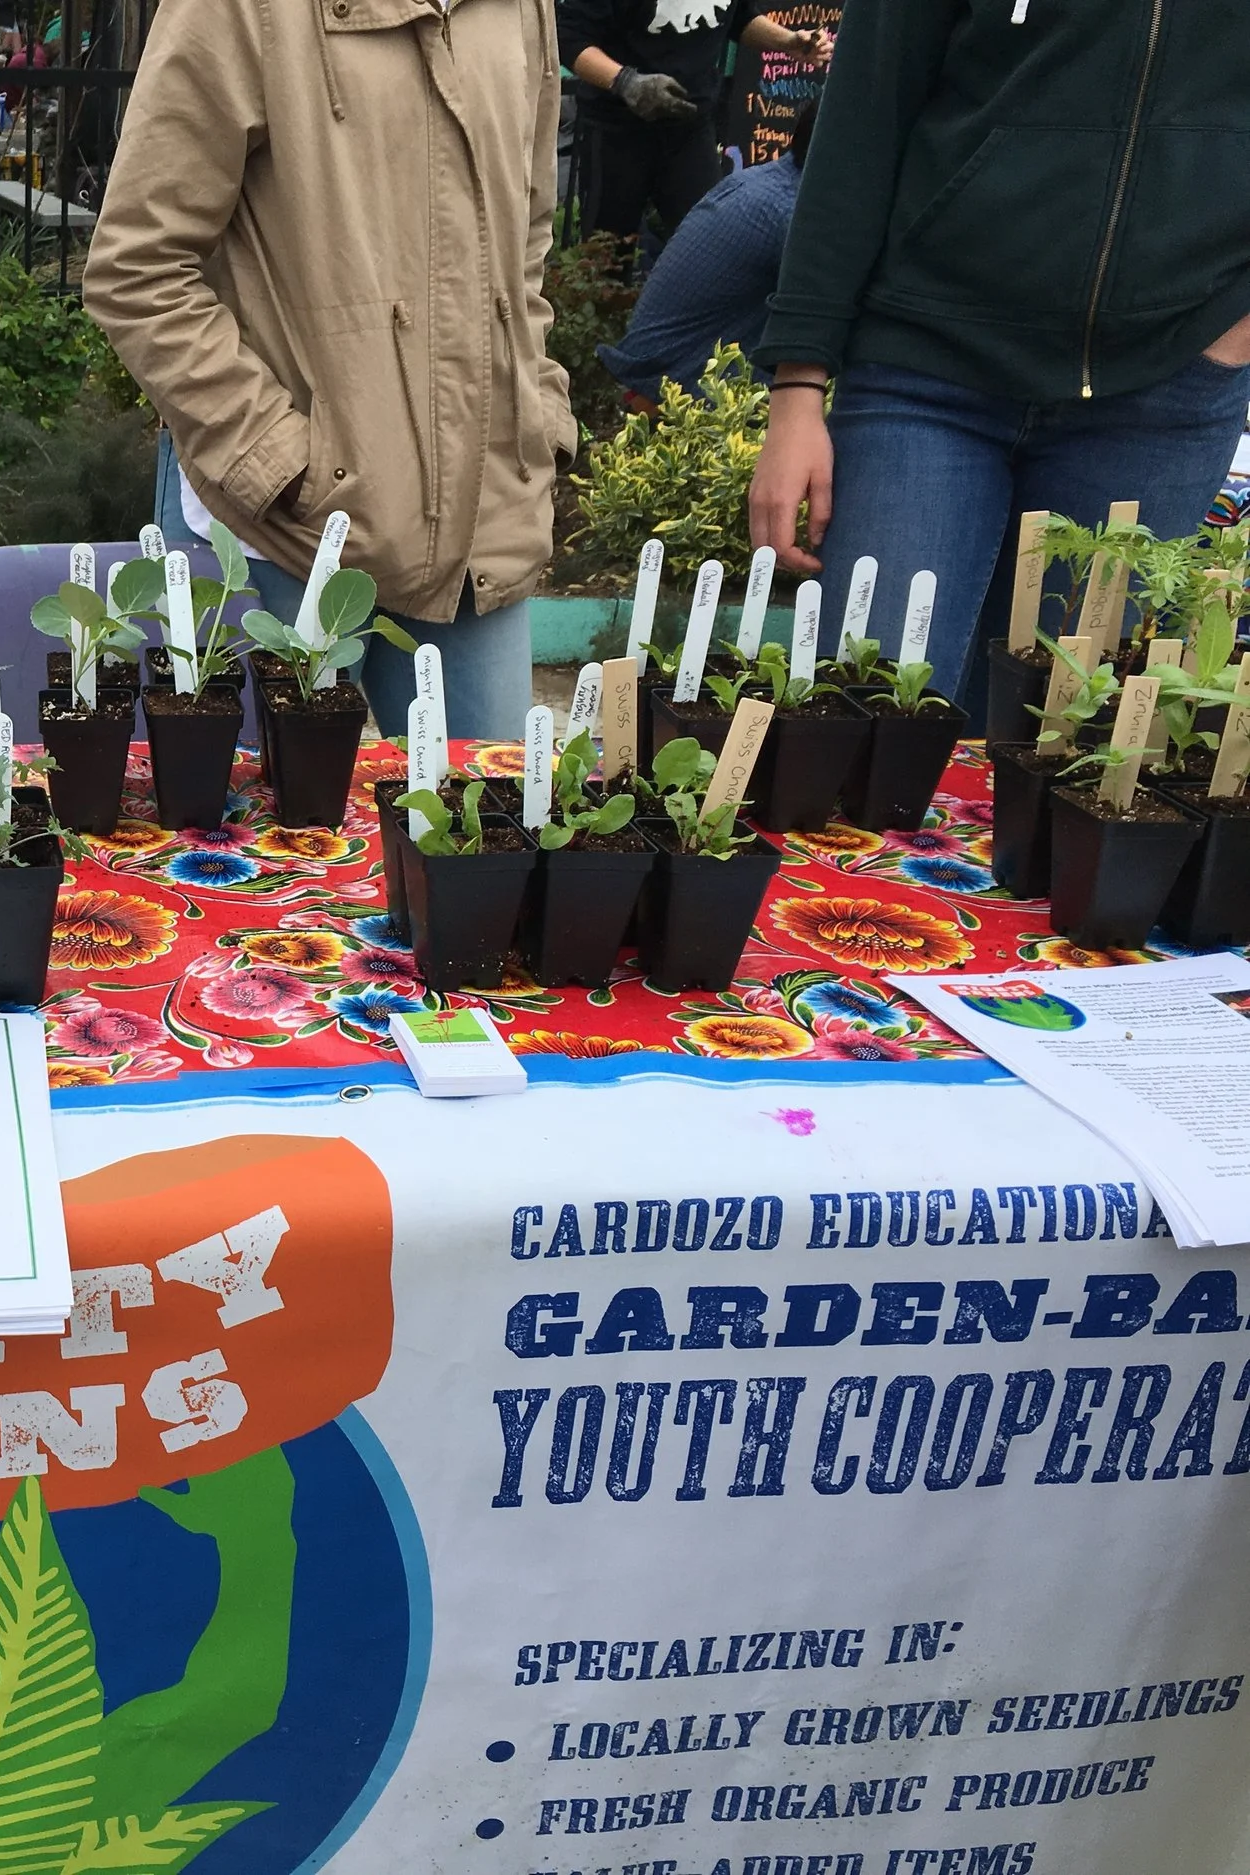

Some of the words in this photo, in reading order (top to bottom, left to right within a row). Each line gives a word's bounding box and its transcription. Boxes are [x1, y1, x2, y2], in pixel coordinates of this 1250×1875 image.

[698, 569, 718, 607] Calendula
[800, 610, 816, 647] Calendula
[909, 605, 932, 646] Calendula
[1127, 686, 1152, 746] Zinnia
[510, 1195, 784, 1260] CARDOZO
[504, 1270, 1250, 1358] GARDEN-BA
[492, 1377, 807, 1508] YOUTH
[514, 1628, 864, 1686] SPECIALIZING
[884, 1620, 964, 1664] IN:
[548, 1709, 764, 1762] LOCALLY
[783, 1698, 972, 1747] GROWN
[986, 1673, 1246, 1735] SEEDLINGS
[535, 1788, 691, 1836] FRESH
[711, 1774, 929, 1823] ORGANIC
[945, 1755, 1156, 1812] PRODUCE
